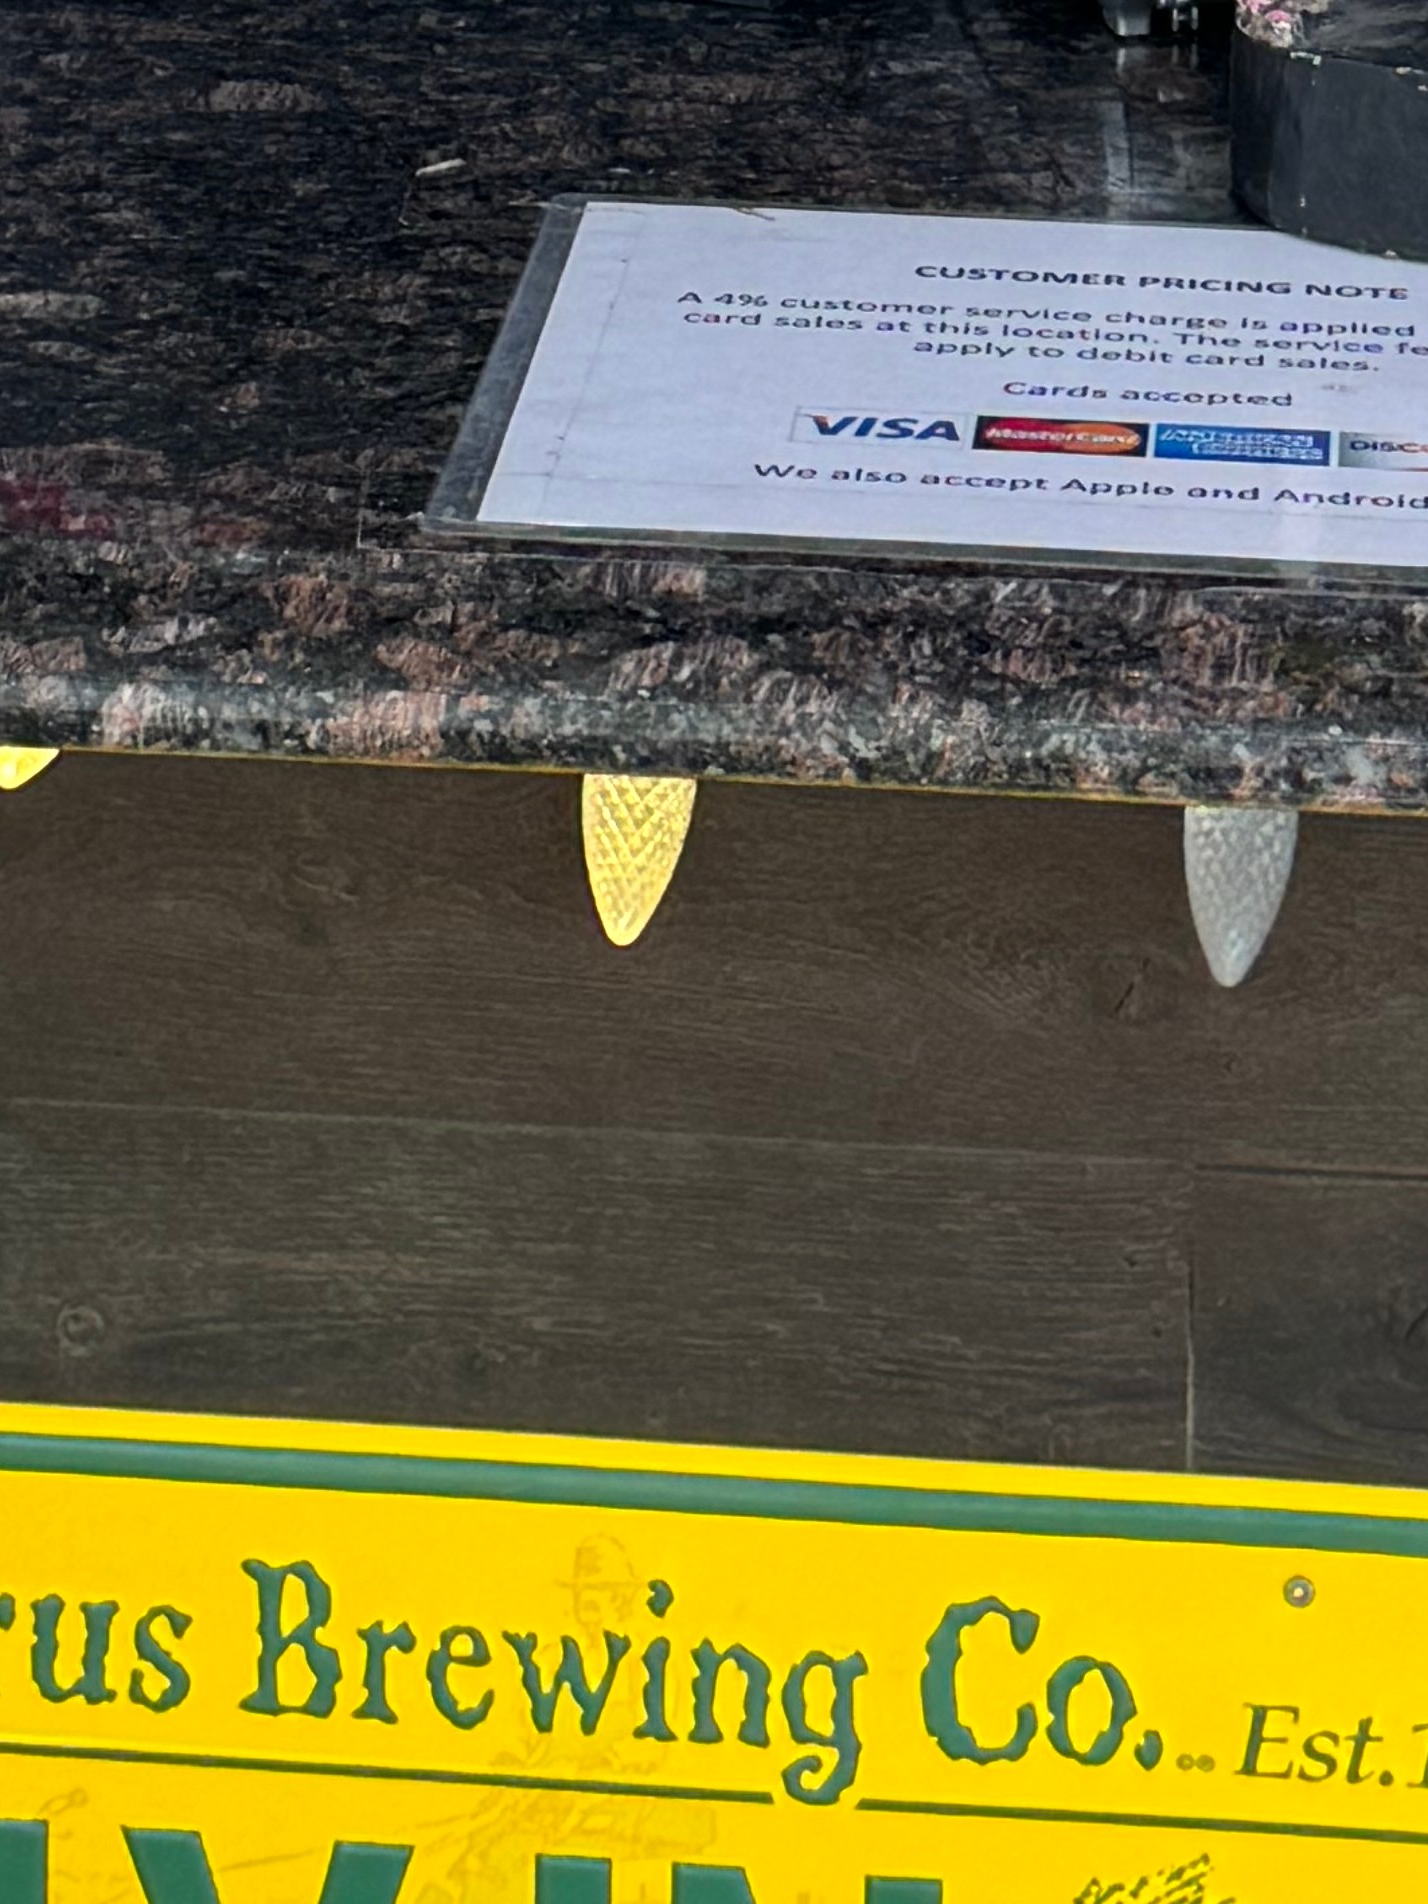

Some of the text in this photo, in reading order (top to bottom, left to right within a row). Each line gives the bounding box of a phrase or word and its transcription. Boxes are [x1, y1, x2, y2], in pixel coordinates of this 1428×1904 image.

[914, 264, 1409, 300] CUSTOMER PRICING NOTE
[677, 291, 703, 305] A
[780, 296, 955, 317] customer
[966, 306, 1092, 324] service
[1104, 309, 1227, 331] charge
[1241, 317, 1268, 332] is
[1279, 322, 1414, 341] applied
[683, 310, 761, 327] card
[774, 315, 863, 332] sales
[875, 319, 912, 334] at
[924, 320, 989, 337] this
[1001, 323, 1160, 344] location.
[1174, 332, 1241, 349] The
[1253, 337, 1384, 355] service
[912, 340, 1380, 373] apply to debit card sales.
[1002, 380, 1293, 409] Cards accepted
[804, 414, 961, 442] VISA
[754, 463, 818, 480] We
[831, 467, 907, 484] also
[920, 473, 1049, 493] accept
[1060, 478, 1174, 496] Apple
[1187, 486, 1260, 501] and
[239, 1558, 870, 1806] Brewing
[918, 1596, 1165, 1772] Co.
